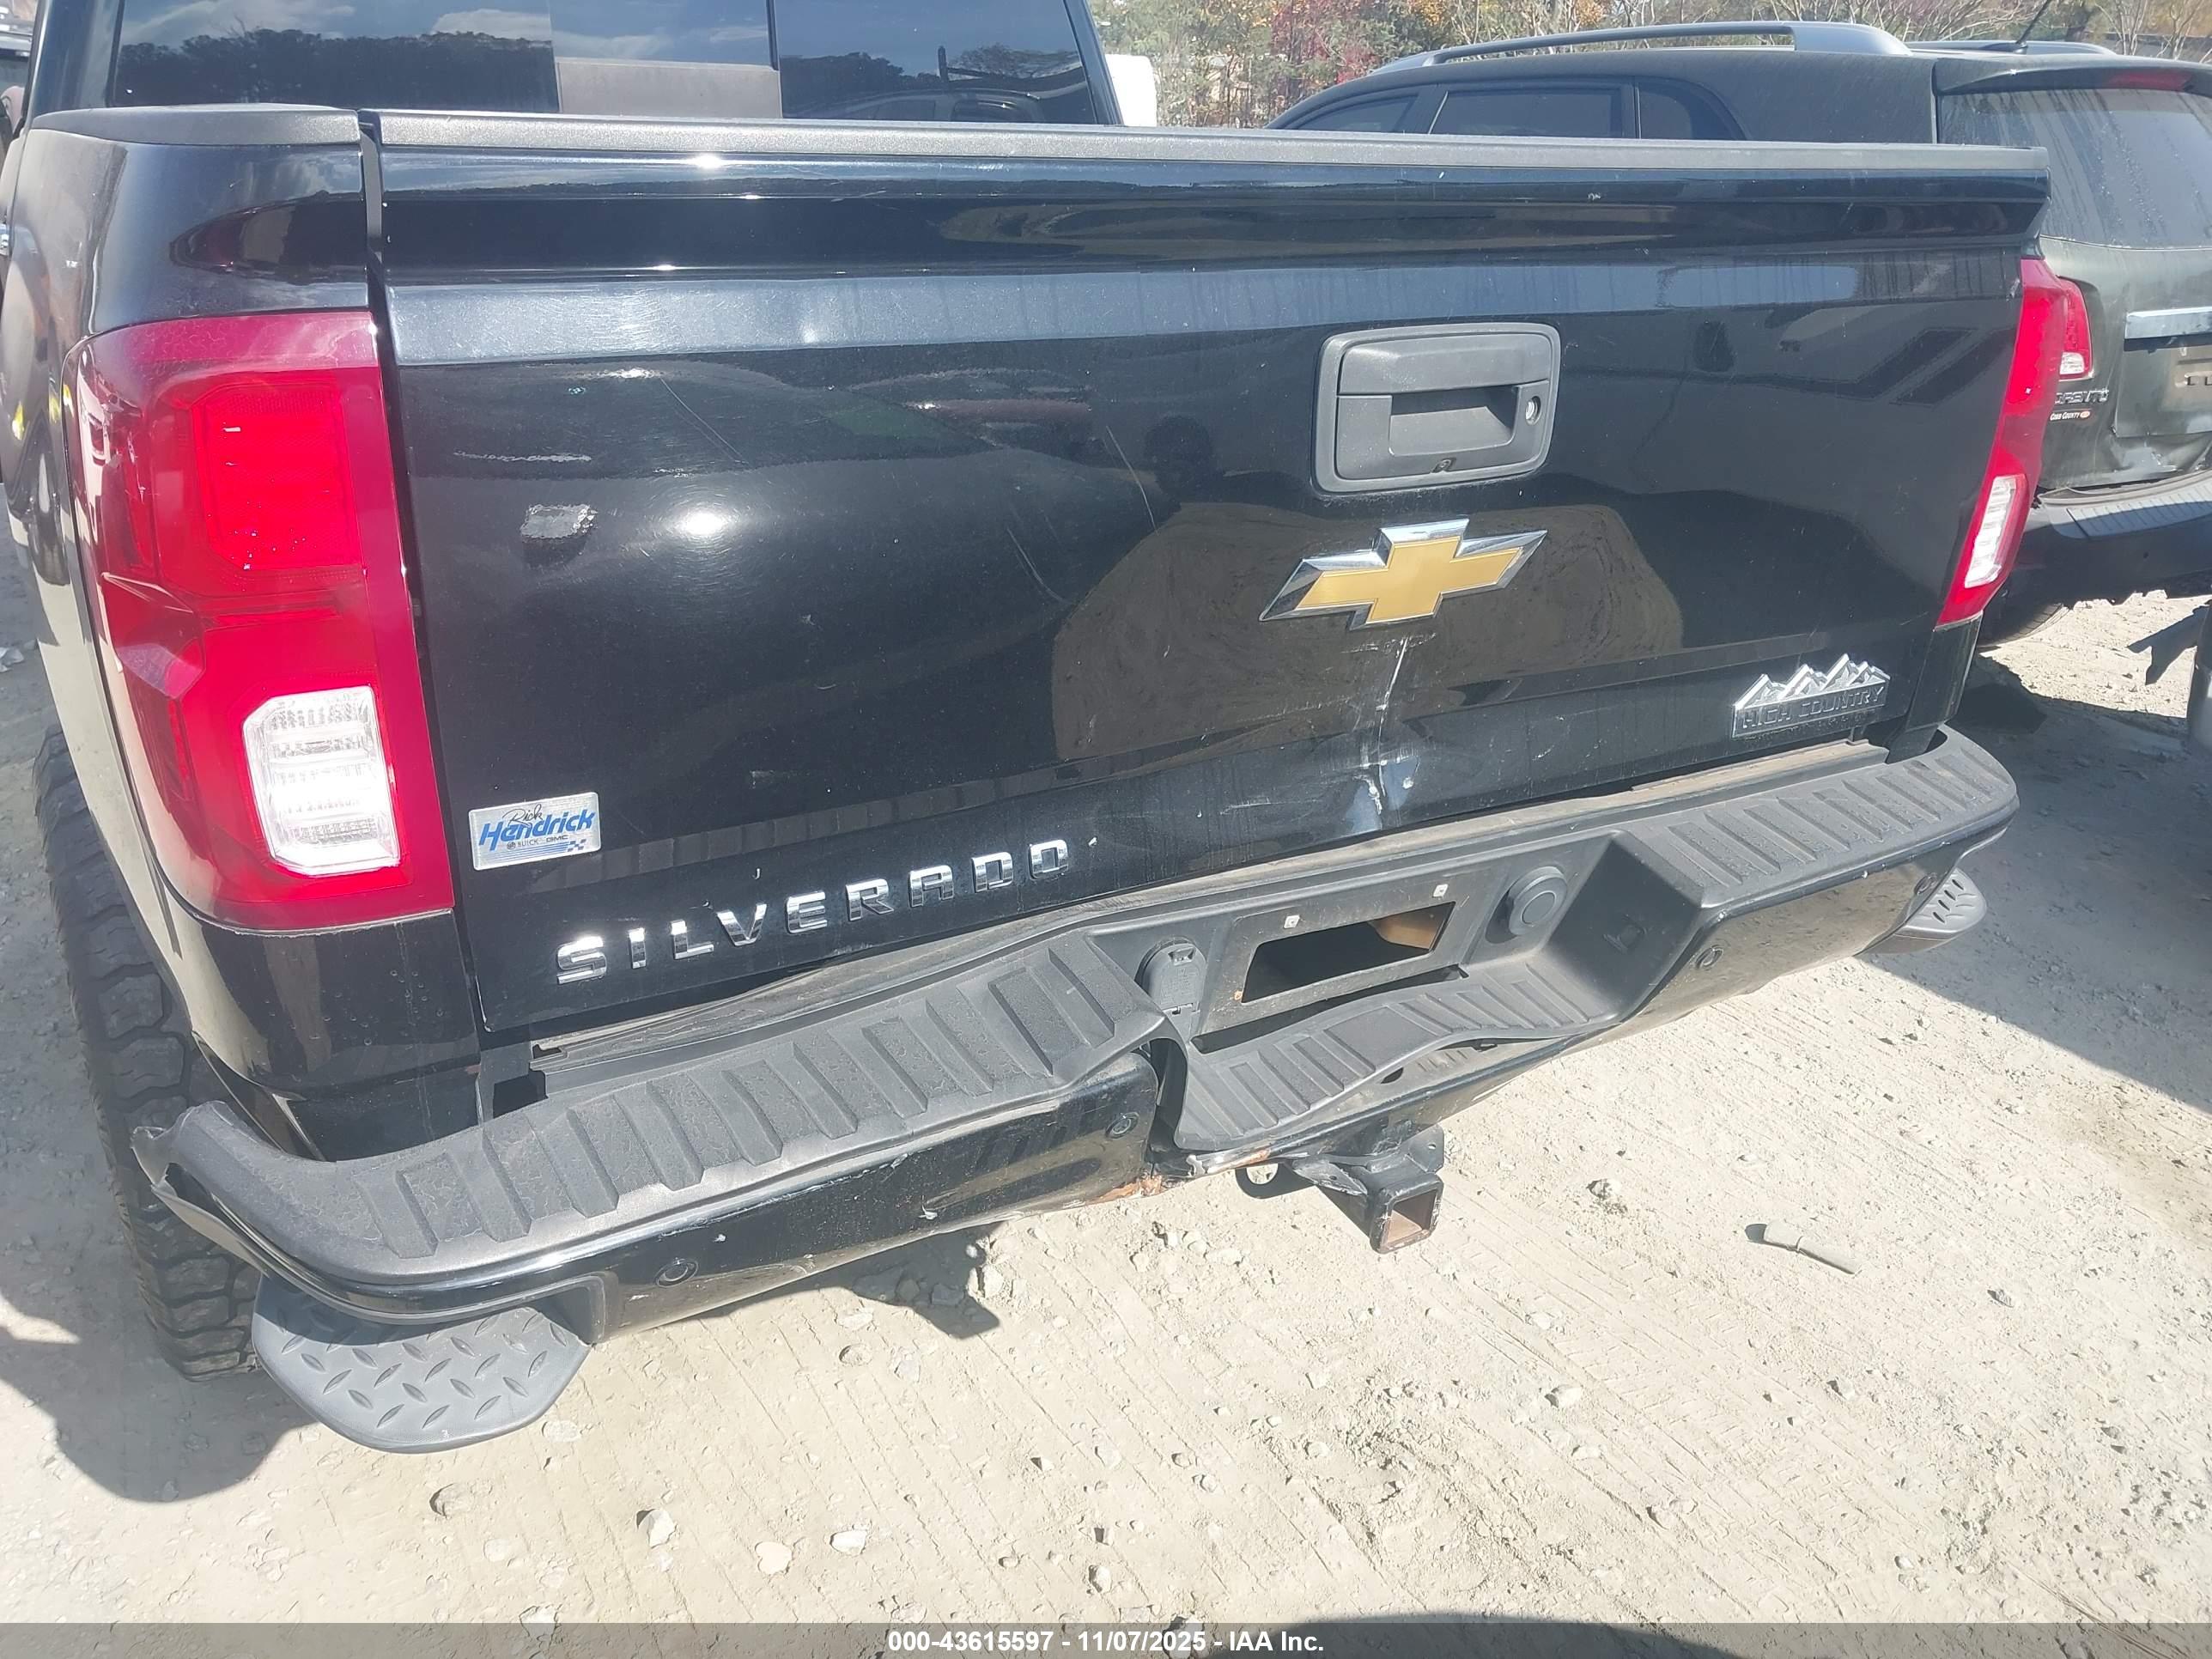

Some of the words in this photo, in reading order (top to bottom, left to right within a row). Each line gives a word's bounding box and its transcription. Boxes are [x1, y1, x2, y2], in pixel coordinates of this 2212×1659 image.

[1741, 704, 1792, 729] HIGH
[1798, 686, 1885, 718] COUNTRY
[478, 809, 596, 851] Hendrick
[502, 803, 544, 827] Rick
[517, 839, 539, 848] BUICK
[546, 834, 569, 844] GMC
[556, 839, 1070, 985] SILVERADO
